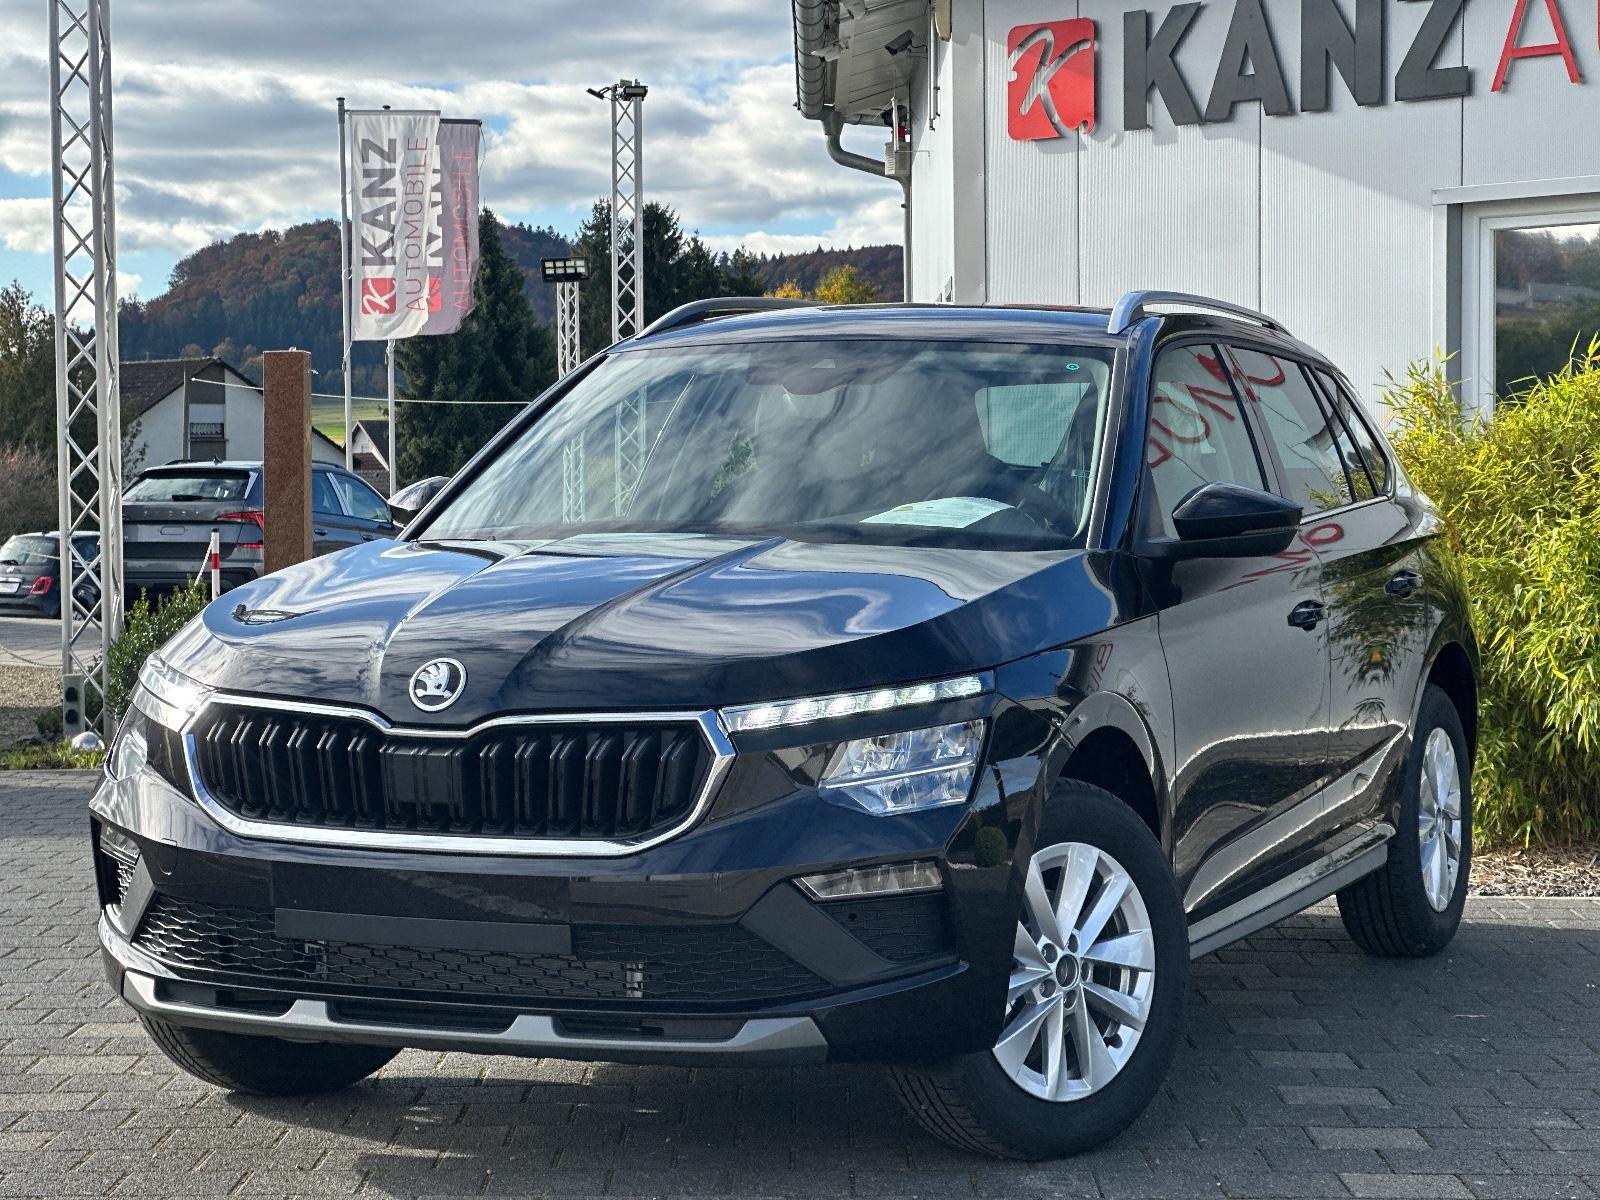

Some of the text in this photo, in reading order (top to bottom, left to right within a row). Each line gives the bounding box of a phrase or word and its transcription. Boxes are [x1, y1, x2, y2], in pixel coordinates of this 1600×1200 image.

[1123, 0, 1469, 131] KANZ
[1490, 0, 1600, 92] A
[361, 138, 397, 266] KANZ
[404, 137, 429, 312] AUTOMOBILE
